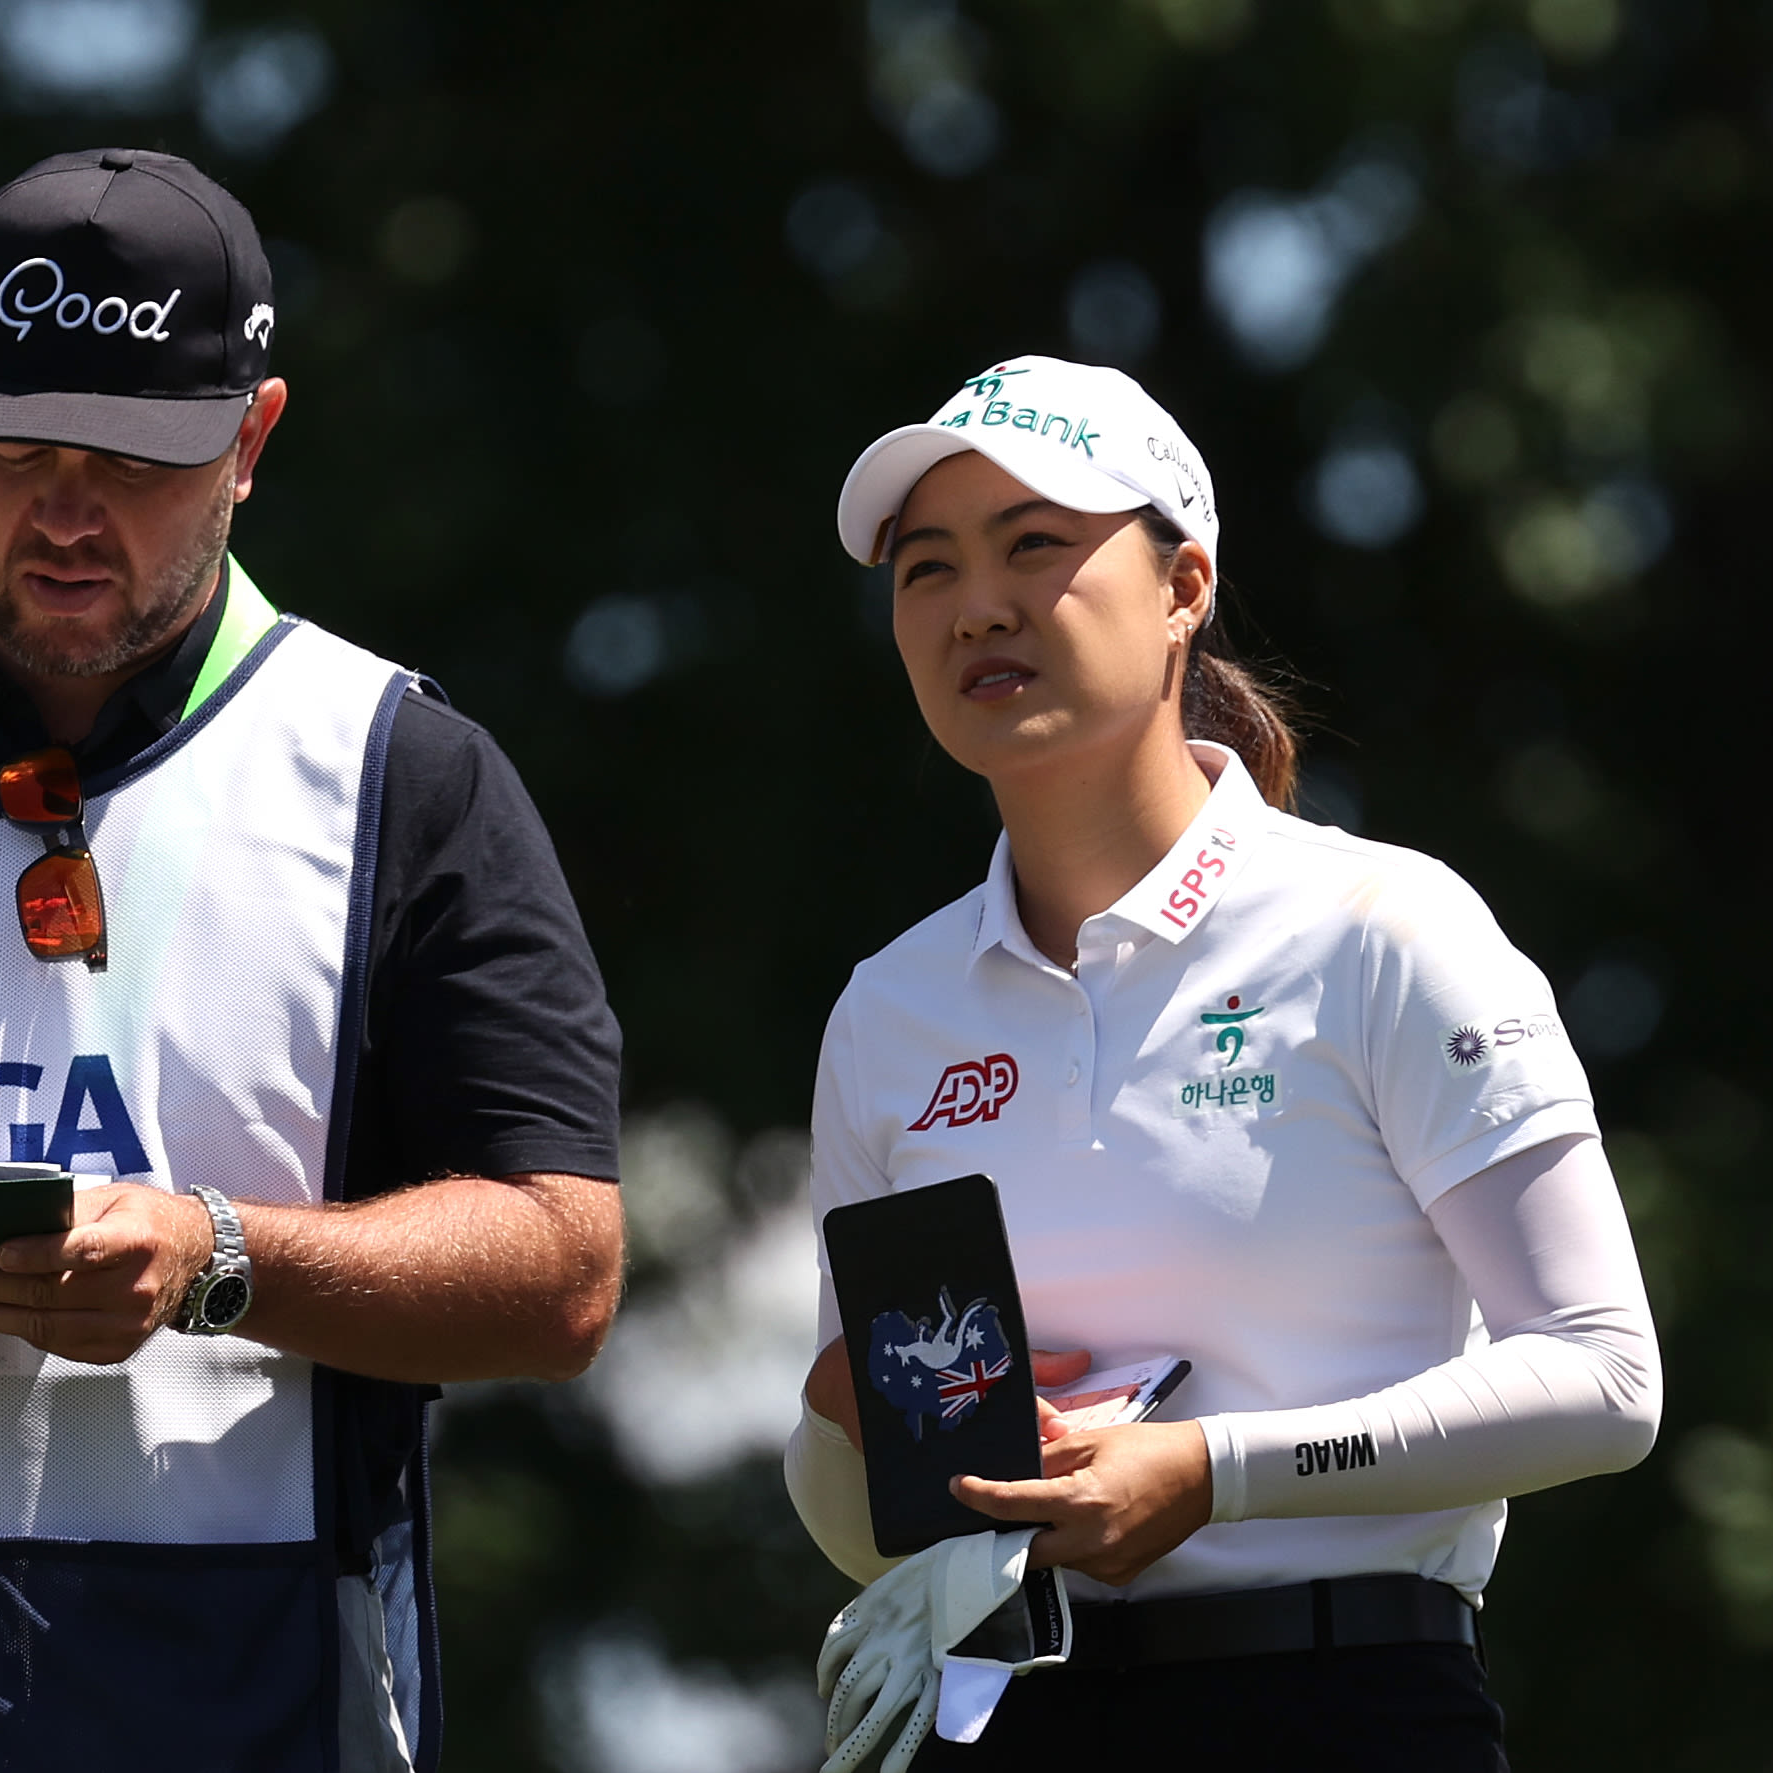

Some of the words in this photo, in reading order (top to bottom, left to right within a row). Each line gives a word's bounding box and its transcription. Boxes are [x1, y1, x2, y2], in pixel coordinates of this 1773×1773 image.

[981, 400, 1101, 459] Bank
[1160, 849, 1226, 929] ISPS
[906, 1052, 1019, 1131] ADP
[1182, 1074, 1275, 1109] 하나은행
[1295, 1432, 1376, 1477] WAAC
